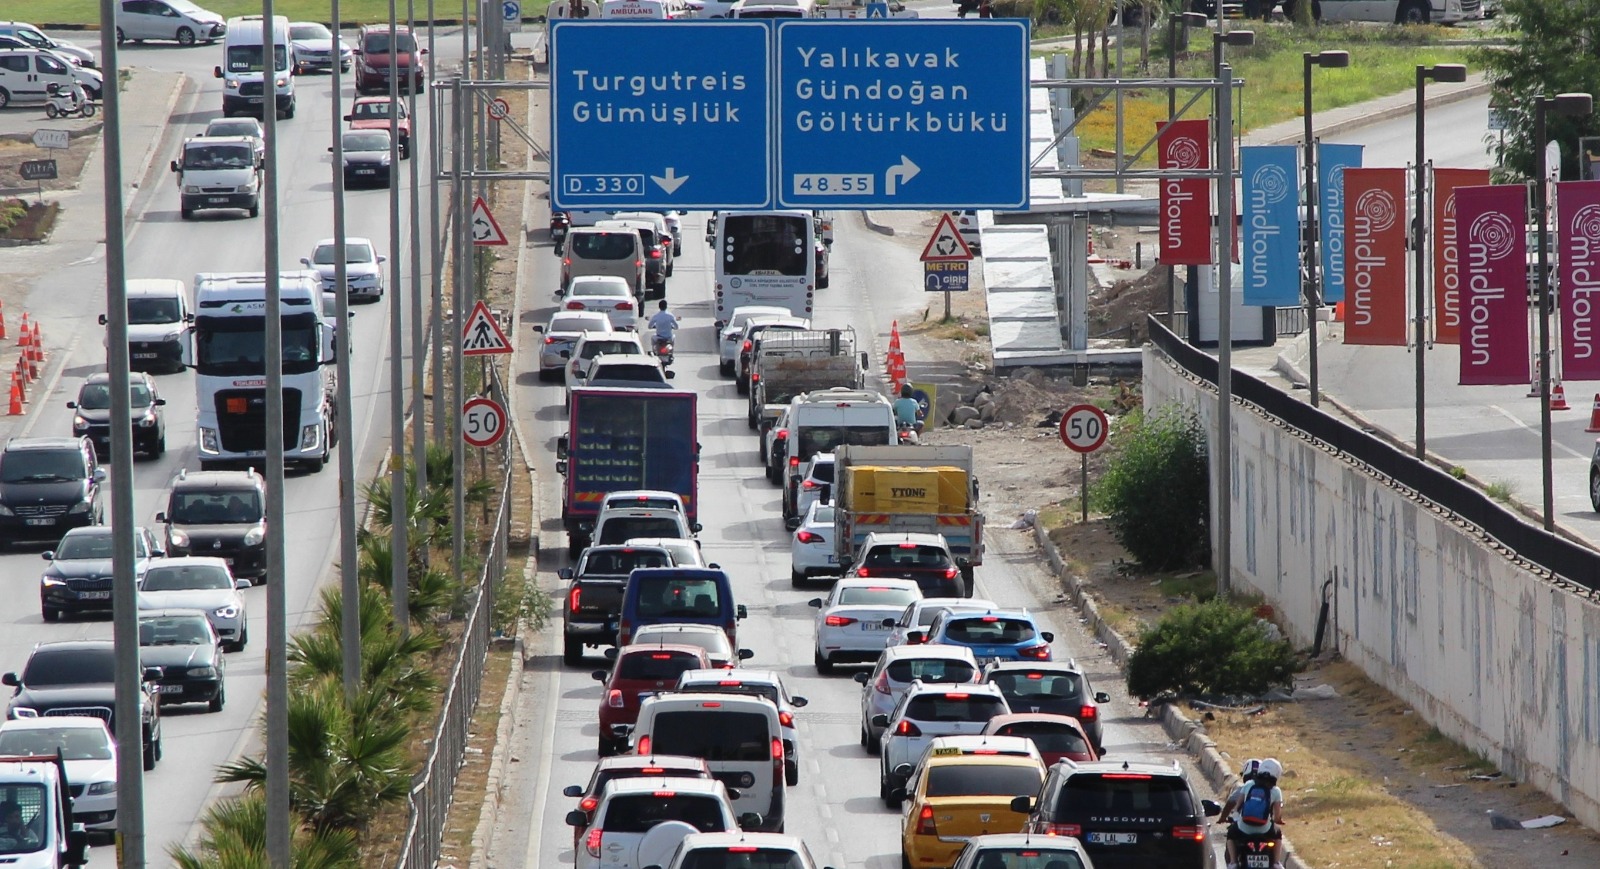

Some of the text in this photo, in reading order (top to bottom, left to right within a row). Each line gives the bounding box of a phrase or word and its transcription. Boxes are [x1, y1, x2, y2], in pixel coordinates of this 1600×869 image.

[798, 47, 959, 69] Yalıkavak
[573, 70, 747, 97] Turgutreis
[796, 79, 968, 105] Gündoğan
[573, 101, 740, 125] Gümüşlük
[796, 110, 1008, 132] Göltürkbükü
[25, 162, 55, 174] VitrA
[569, 177, 639, 193] D.330
[799, 177, 869, 193] 48.55
[1166, 160, 1194, 250] midtown
[1252, 189, 1281, 288] midtown
[926, 262, 967, 271] METRO
[1354, 216, 1387, 325] midtown
[1469, 243, 1505, 366] midtown
[1571, 236, 1600, 359] midtown
[468, 411, 497, 434] 50
[1070, 417, 1101, 440] 50
[890, 487, 926, 498] YTONG
[1090, 815, 1163, 823] DISCOVERY
[1091, 832, 1136, 843] 06 LAL 37
